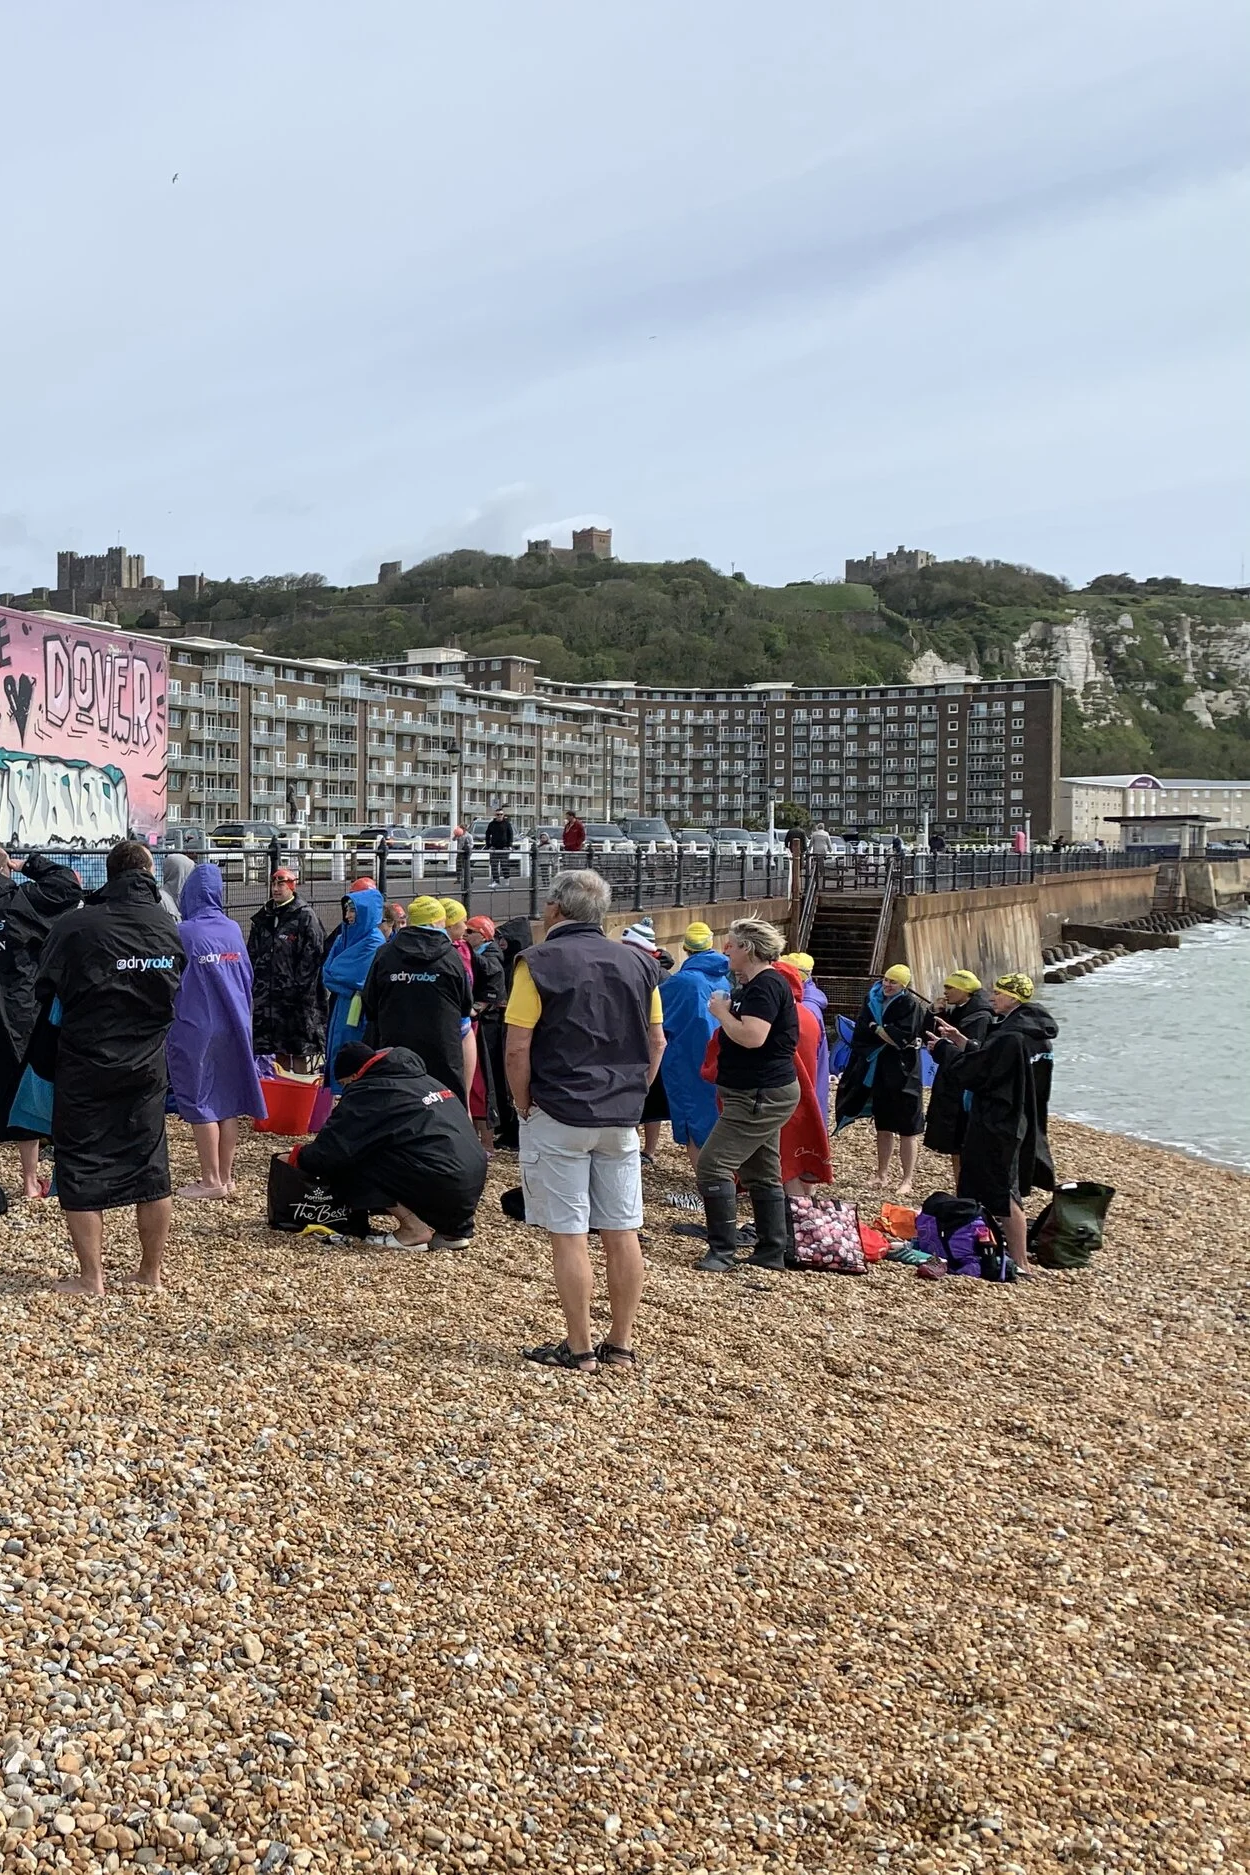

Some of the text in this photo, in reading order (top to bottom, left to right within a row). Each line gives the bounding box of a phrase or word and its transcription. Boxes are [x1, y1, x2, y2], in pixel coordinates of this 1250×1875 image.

[43, 633, 152, 748] DOVER
[289, 1202, 348, 1224] The Best
